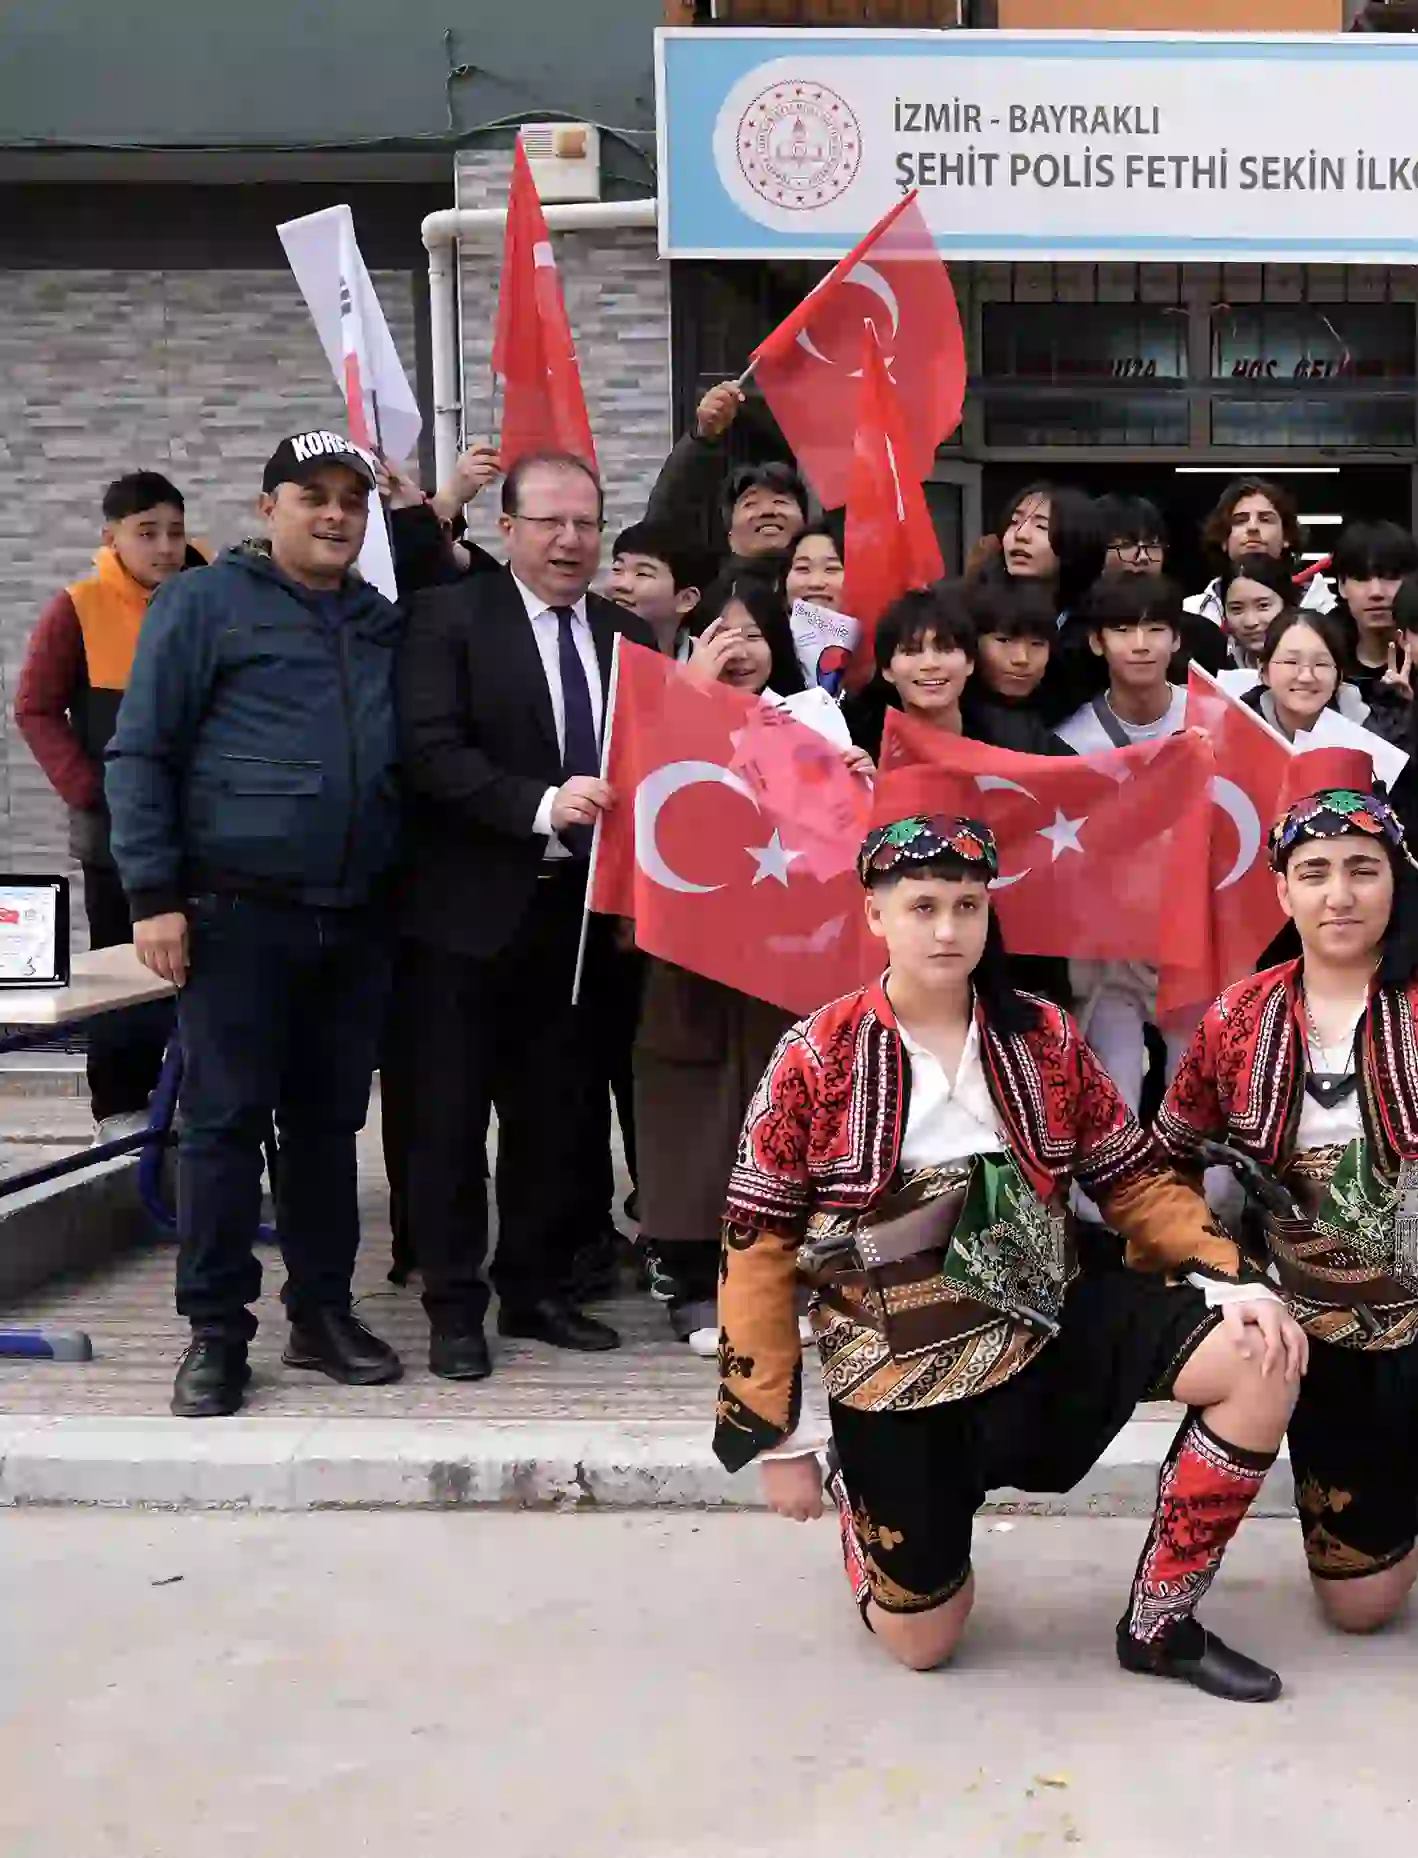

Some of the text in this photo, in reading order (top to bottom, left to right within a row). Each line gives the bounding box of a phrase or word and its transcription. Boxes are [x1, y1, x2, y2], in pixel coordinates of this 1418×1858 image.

[894, 95, 982, 132] İZMİR
[1009, 104, 1160, 134] BAYRAKLI
[895, 145, 1000, 194] ŞEHİT
[1010, 146, 1114, 188] POLİS
[1127, 148, 1227, 188] FETHİ
[1239, 149, 1345, 190] SEKİN
